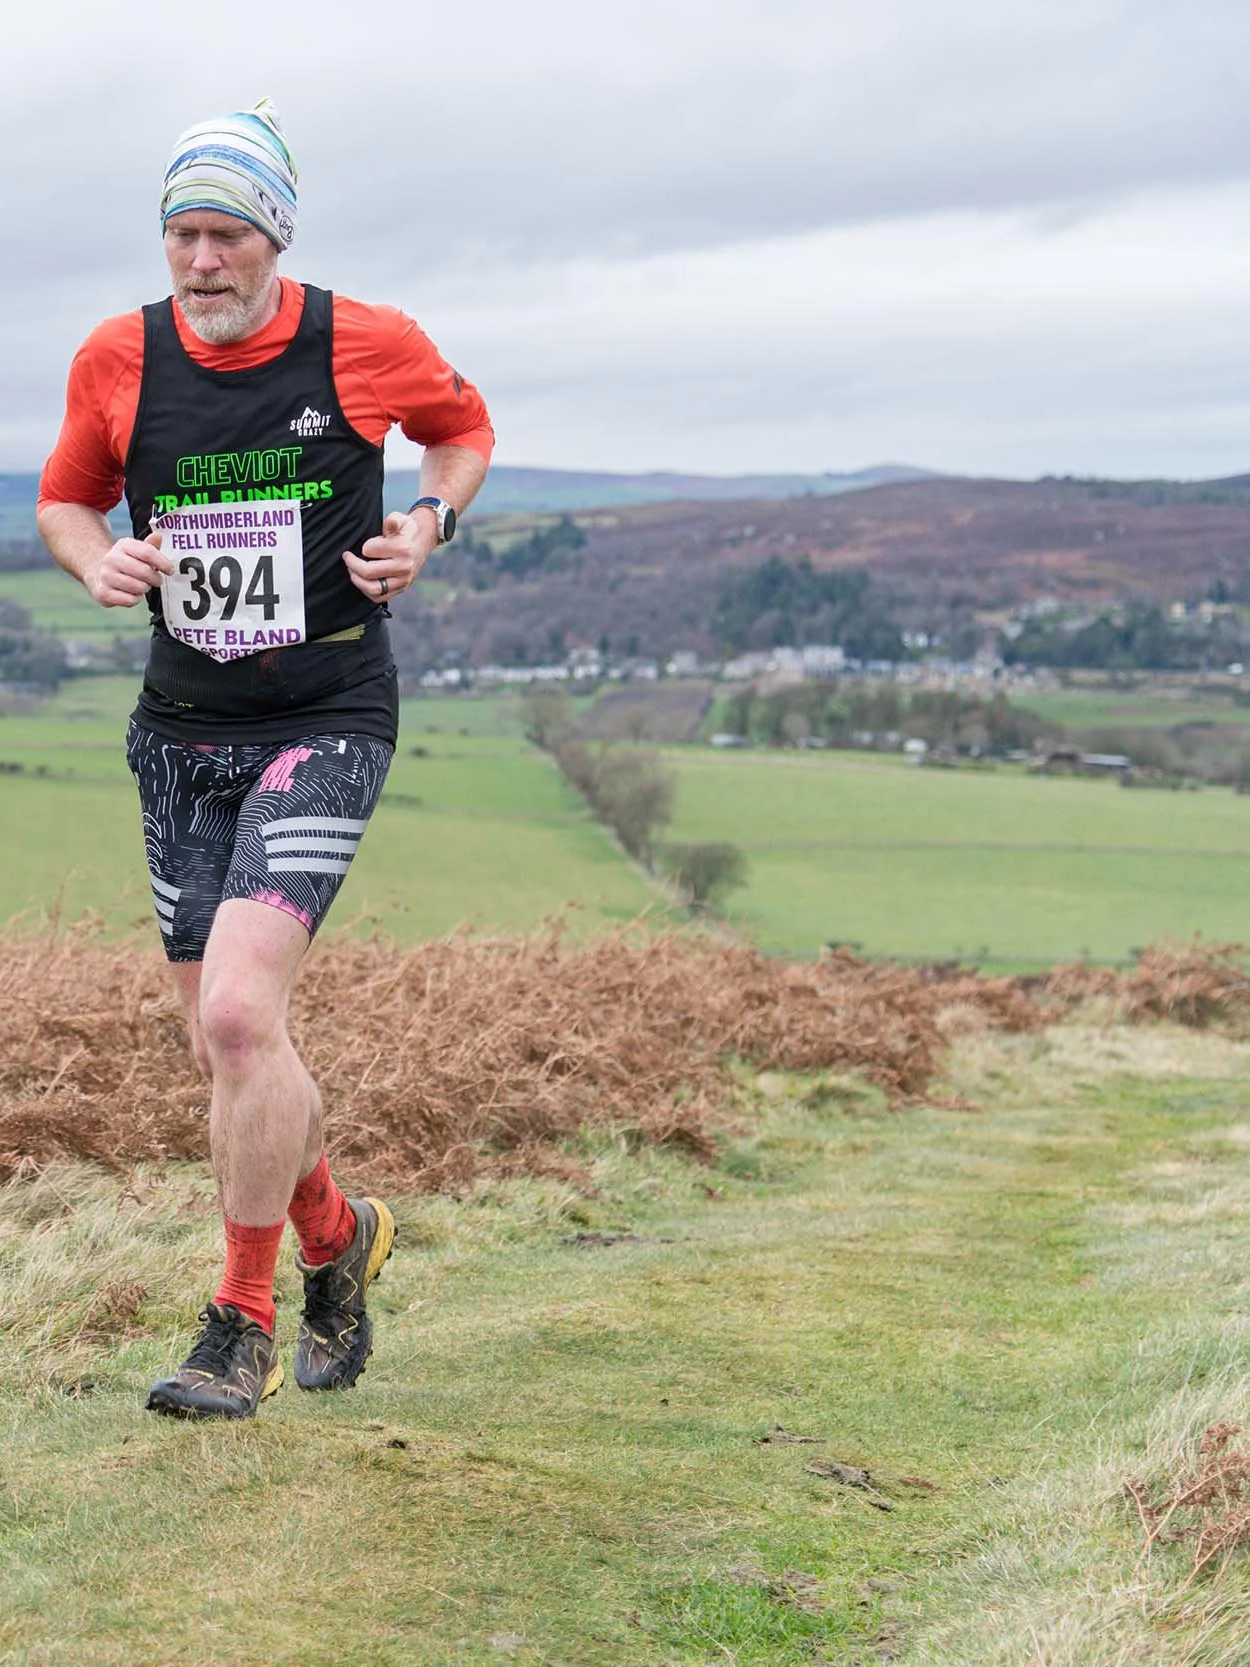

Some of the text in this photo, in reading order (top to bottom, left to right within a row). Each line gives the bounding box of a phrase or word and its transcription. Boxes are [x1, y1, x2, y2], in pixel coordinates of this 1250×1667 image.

[290, 413, 331, 431] SUMMIT
[176, 446, 303, 488] CHEVIOT
[220, 480, 333, 504] RUNNERS
[155, 510, 295, 530] NORTHUMBERLAND
[172, 531, 278, 550] FELL RUNNERS
[178, 555, 280, 621] 394
[173, 627, 301, 646] PETE BLAND
